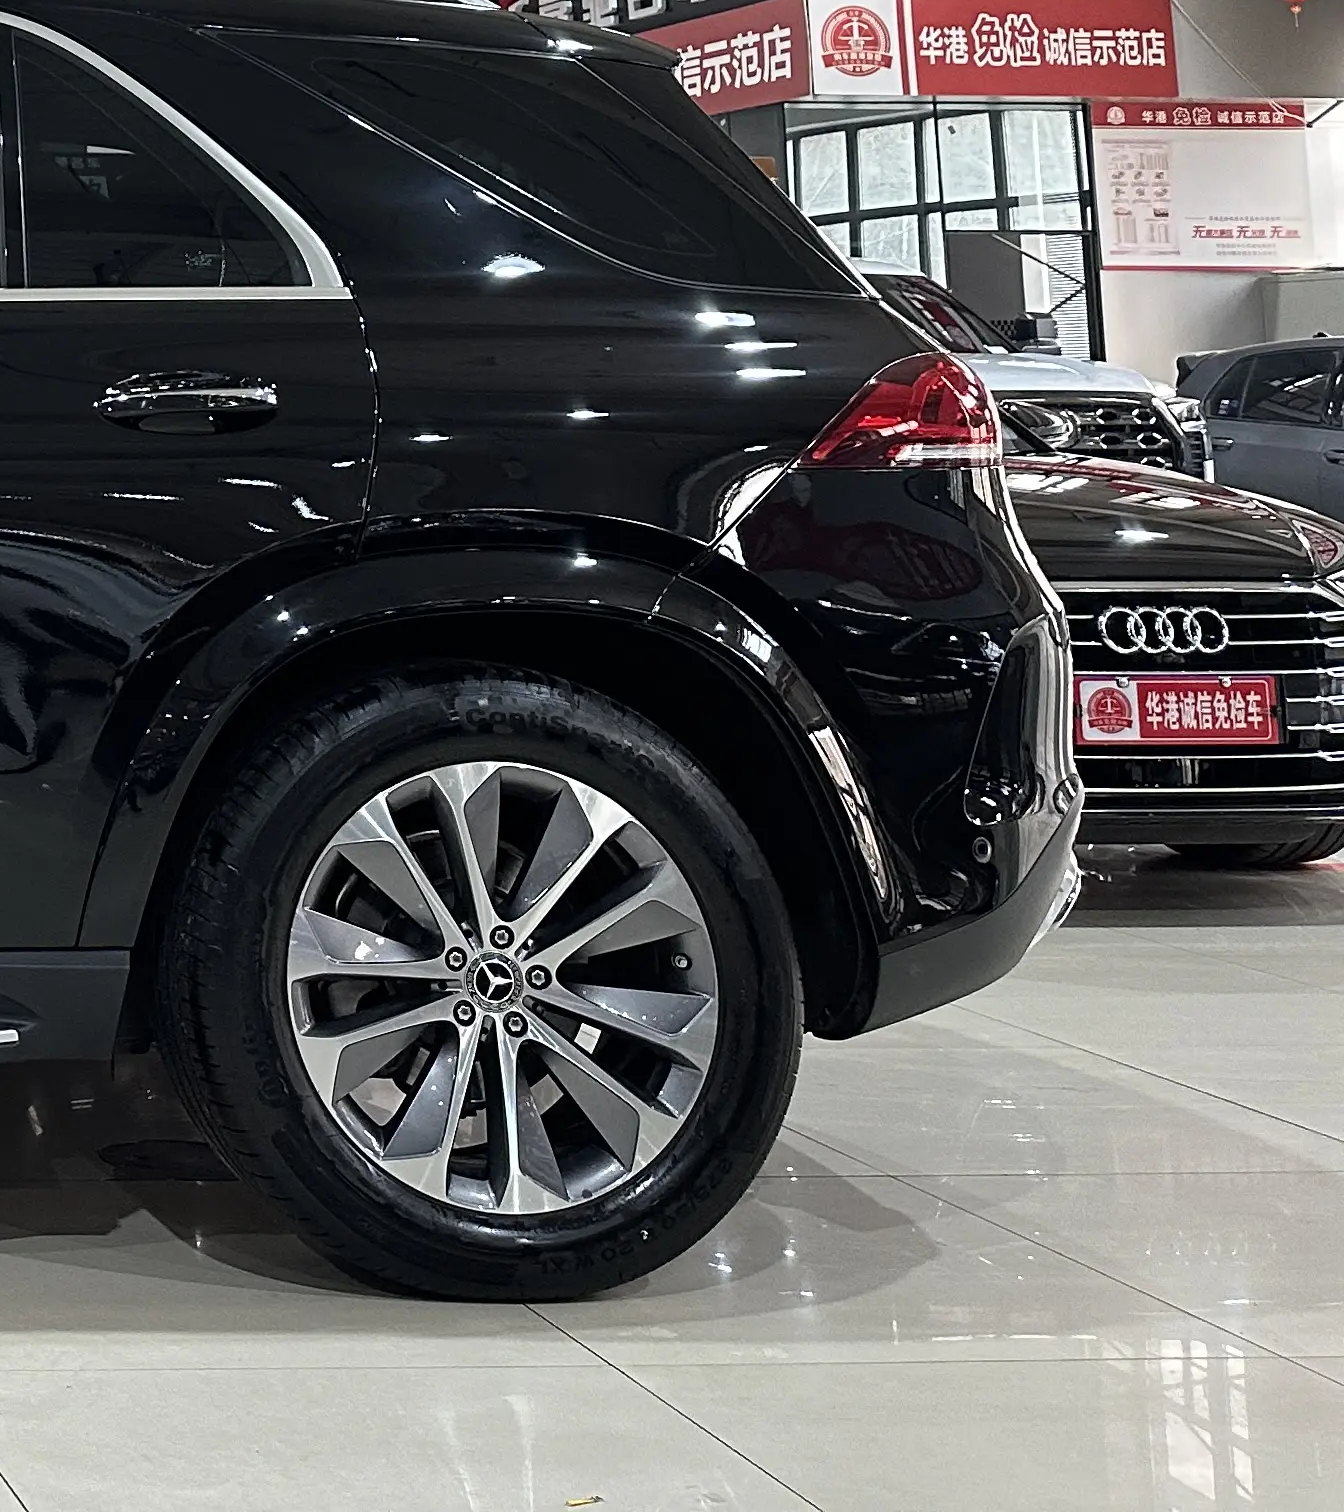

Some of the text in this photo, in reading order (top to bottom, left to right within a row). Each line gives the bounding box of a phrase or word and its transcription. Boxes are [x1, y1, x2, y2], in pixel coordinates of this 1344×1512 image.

[918, 12, 1167, 68] 华港免检诚信示范店
[1141, 106, 1285, 126] 华港免检诚信示范店
[1144, 690, 1263, 731] 华港诚信免检车
